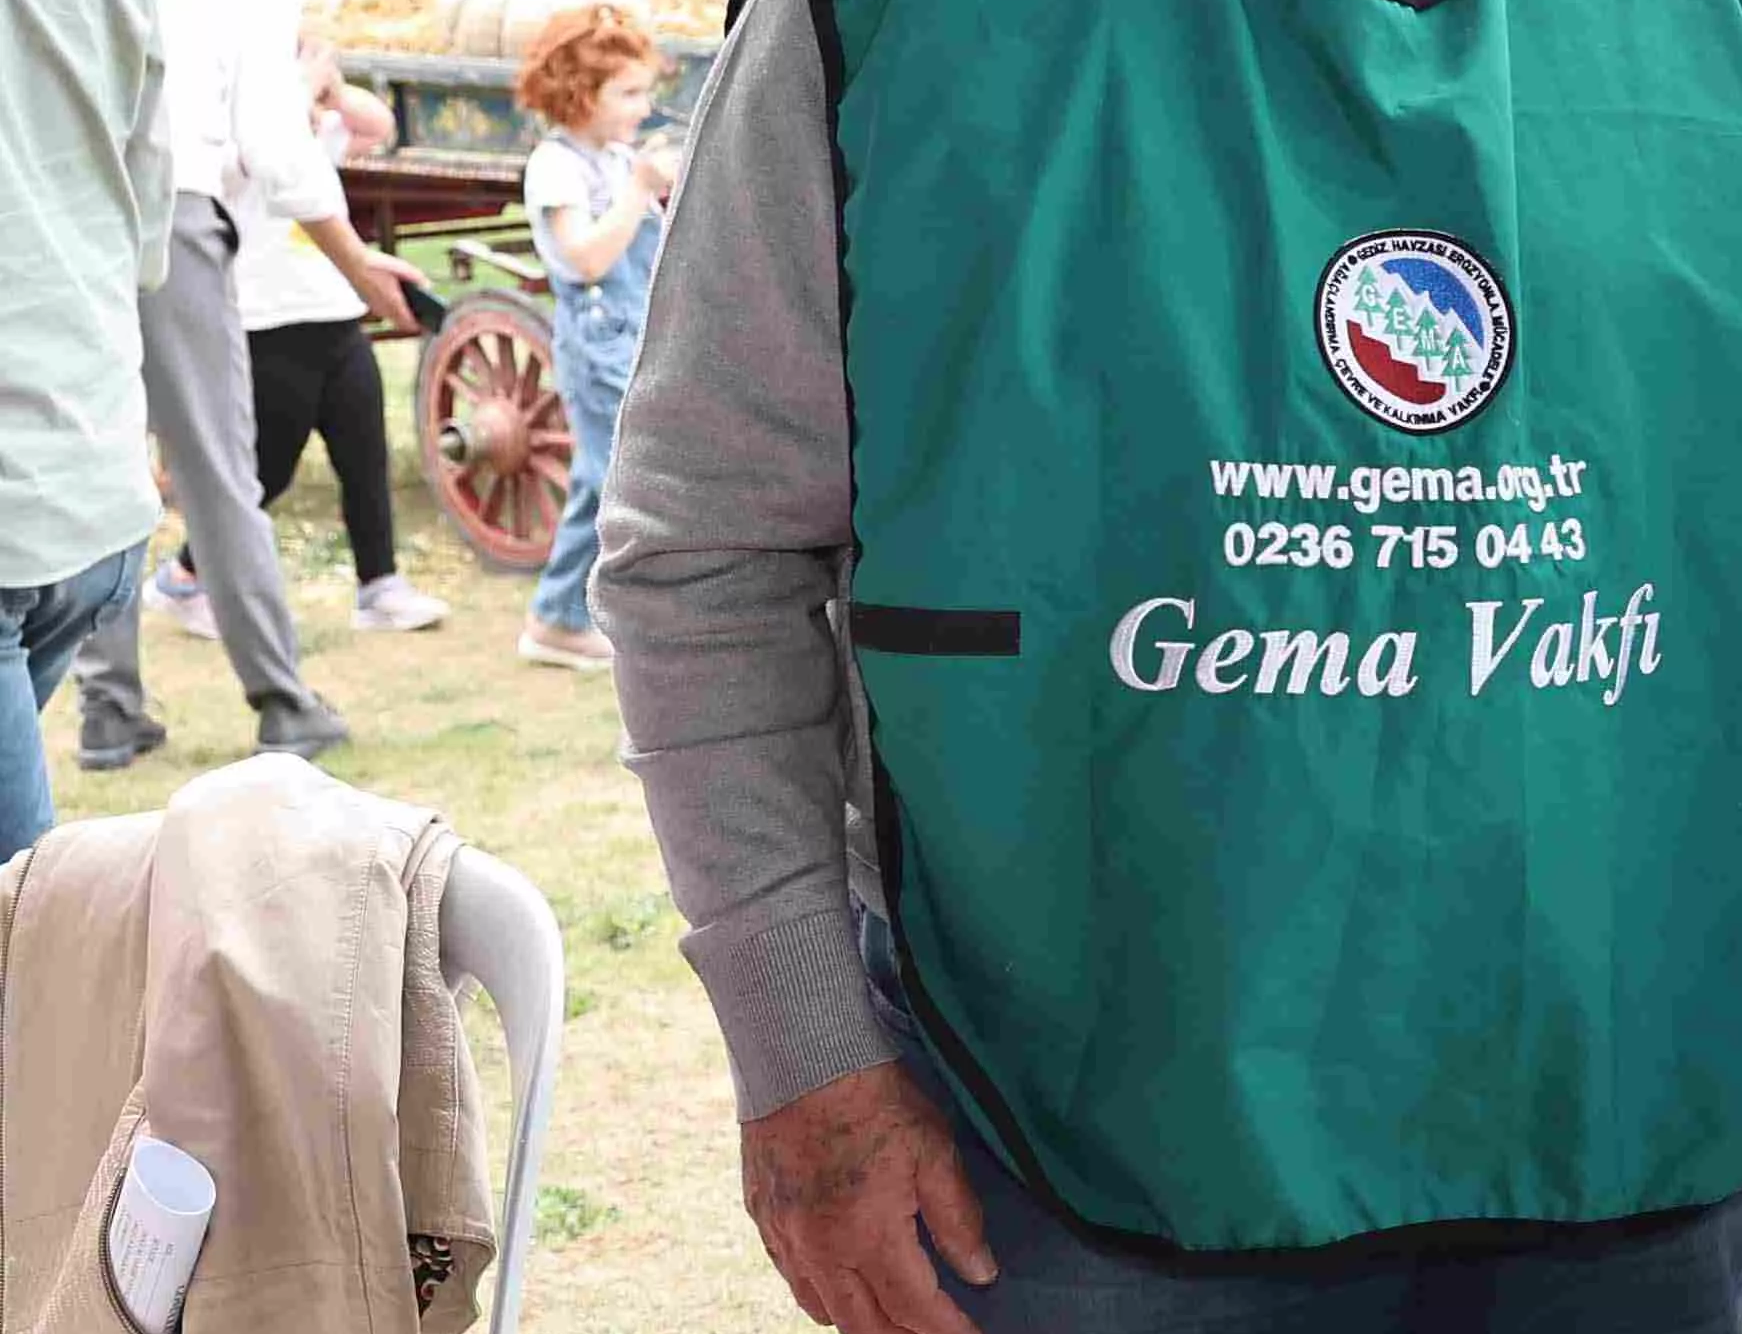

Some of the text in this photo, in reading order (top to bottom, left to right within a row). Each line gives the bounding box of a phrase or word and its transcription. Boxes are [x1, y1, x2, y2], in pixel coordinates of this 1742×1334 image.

[1210, 453, 1588, 513] www.gema.org.tr
[1223, 517, 1587, 570] 0236 715 04 43
[1109, 596, 1419, 698] Gema
